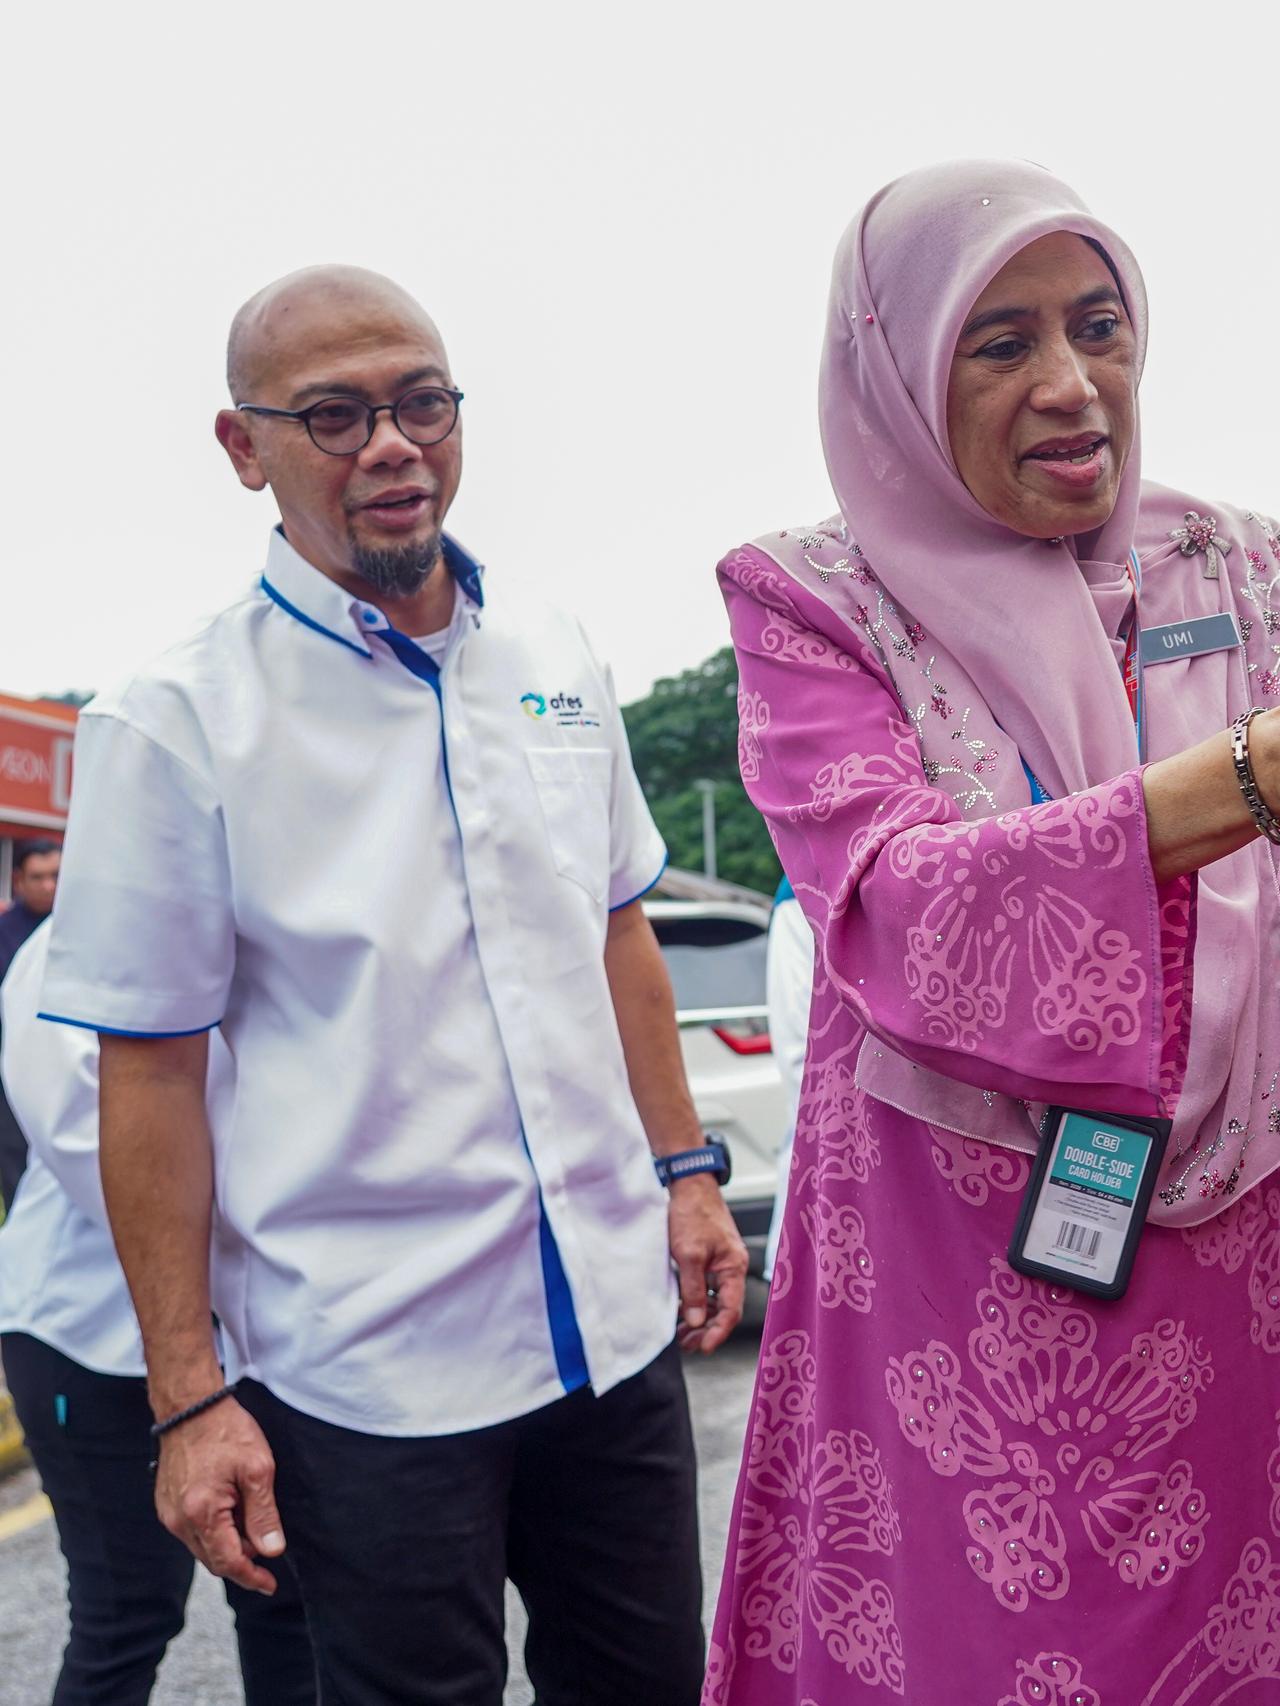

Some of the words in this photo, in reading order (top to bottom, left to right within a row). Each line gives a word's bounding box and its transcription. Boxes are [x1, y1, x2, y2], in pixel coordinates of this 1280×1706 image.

[1162, 630, 1194, 649] UMI
[1095, 1134, 1118, 1149] CBE
[1064, 1145, 1135, 1178] DOUBLE-SIDE
[1068, 1164, 1090, 1179] CARD
[1090, 1171, 1122, 1189] HOLDER
